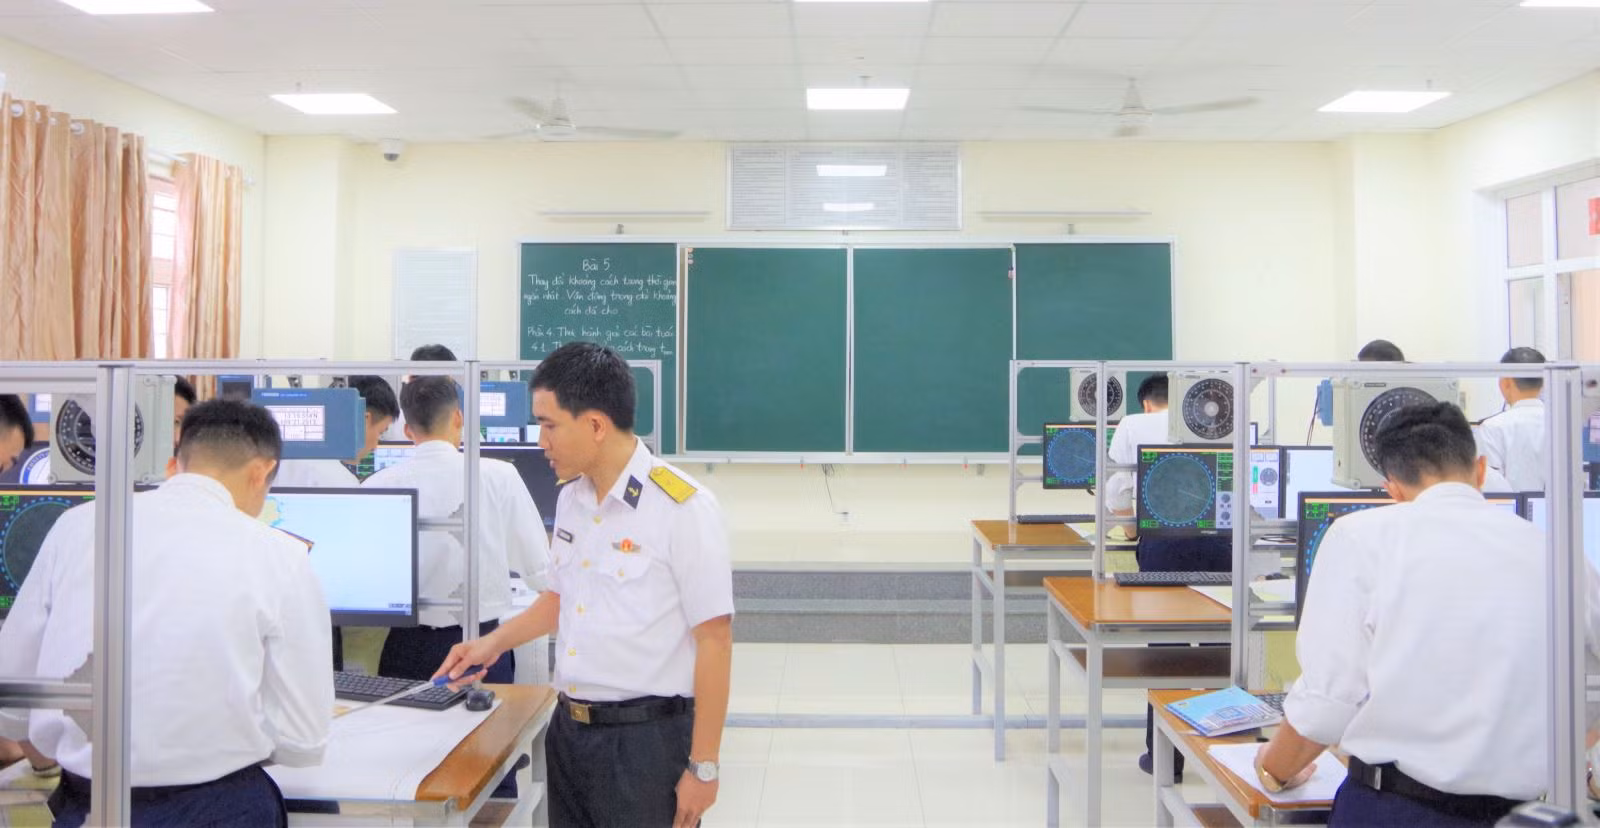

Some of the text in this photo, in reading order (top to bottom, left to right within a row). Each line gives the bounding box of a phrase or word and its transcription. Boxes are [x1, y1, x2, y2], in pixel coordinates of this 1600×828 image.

[582, 257, 611, 272] Bài 5
[527, 273, 549, 291] Thay
[568, 273, 596, 291] khoảng
[600, 273, 619, 286] cách
[601, 304, 619, 315] cho
